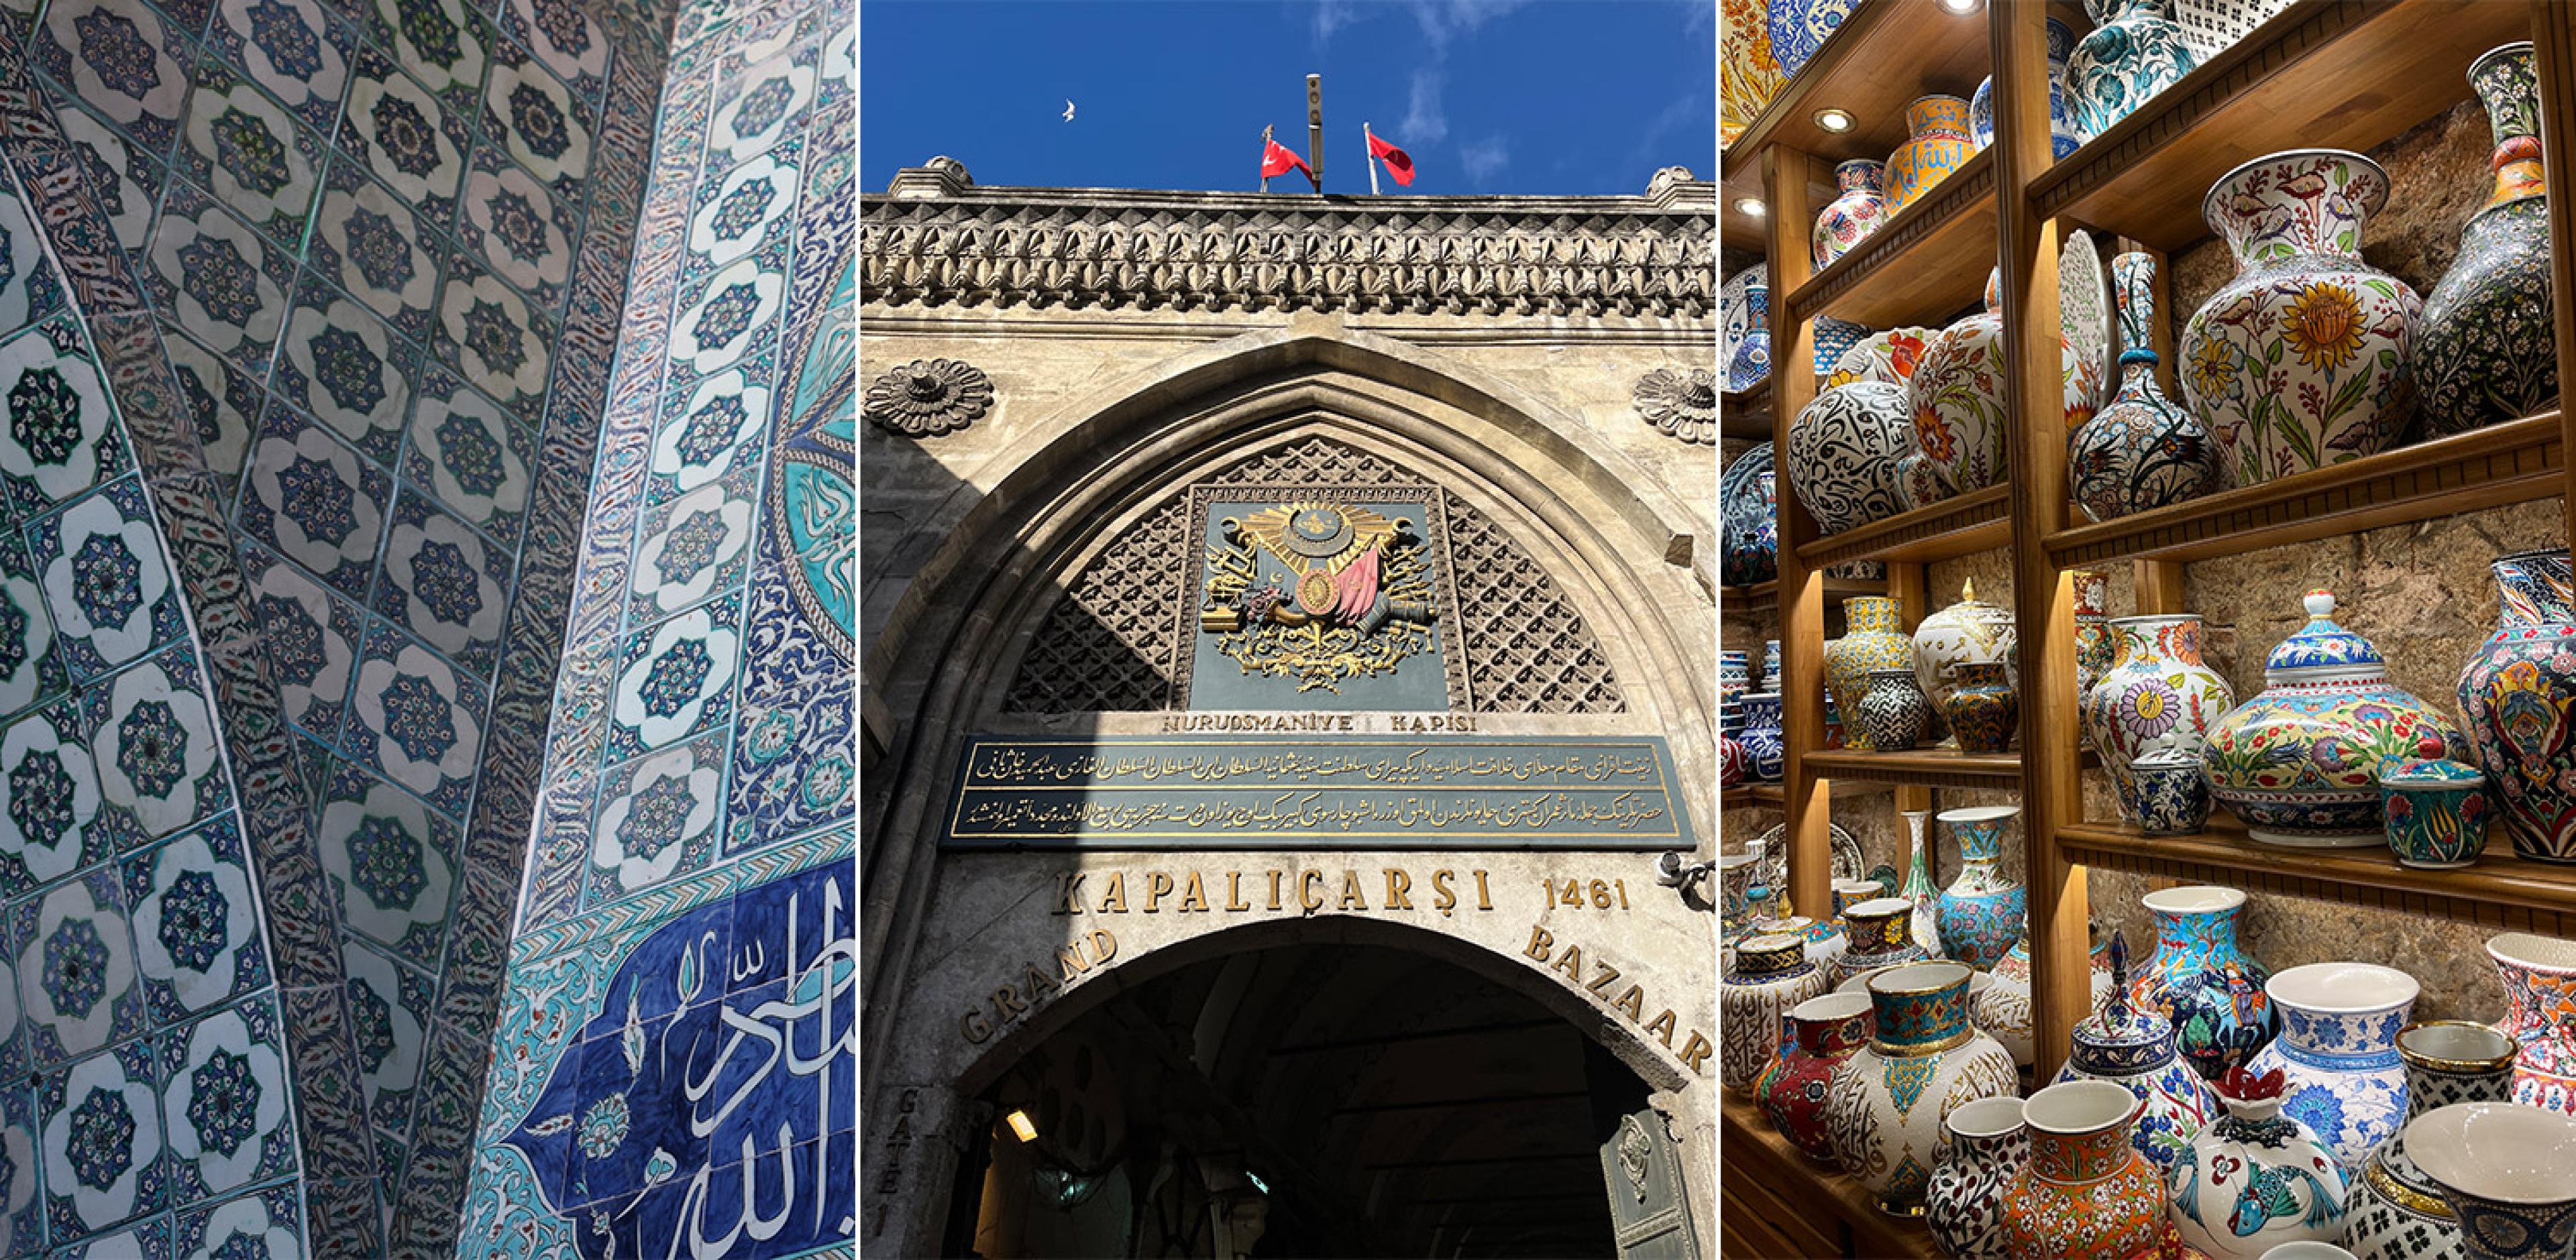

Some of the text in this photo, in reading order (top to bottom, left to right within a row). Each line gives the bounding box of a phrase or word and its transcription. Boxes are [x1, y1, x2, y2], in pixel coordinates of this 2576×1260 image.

[1051, 870, 1629, 918] KAPALIÇARŞI 1461
[960, 928, 1118, 1043] GRAND
[1522, 925, 1713, 1075] BAZAAR
[879, 1089, 918, 1194] GATE
